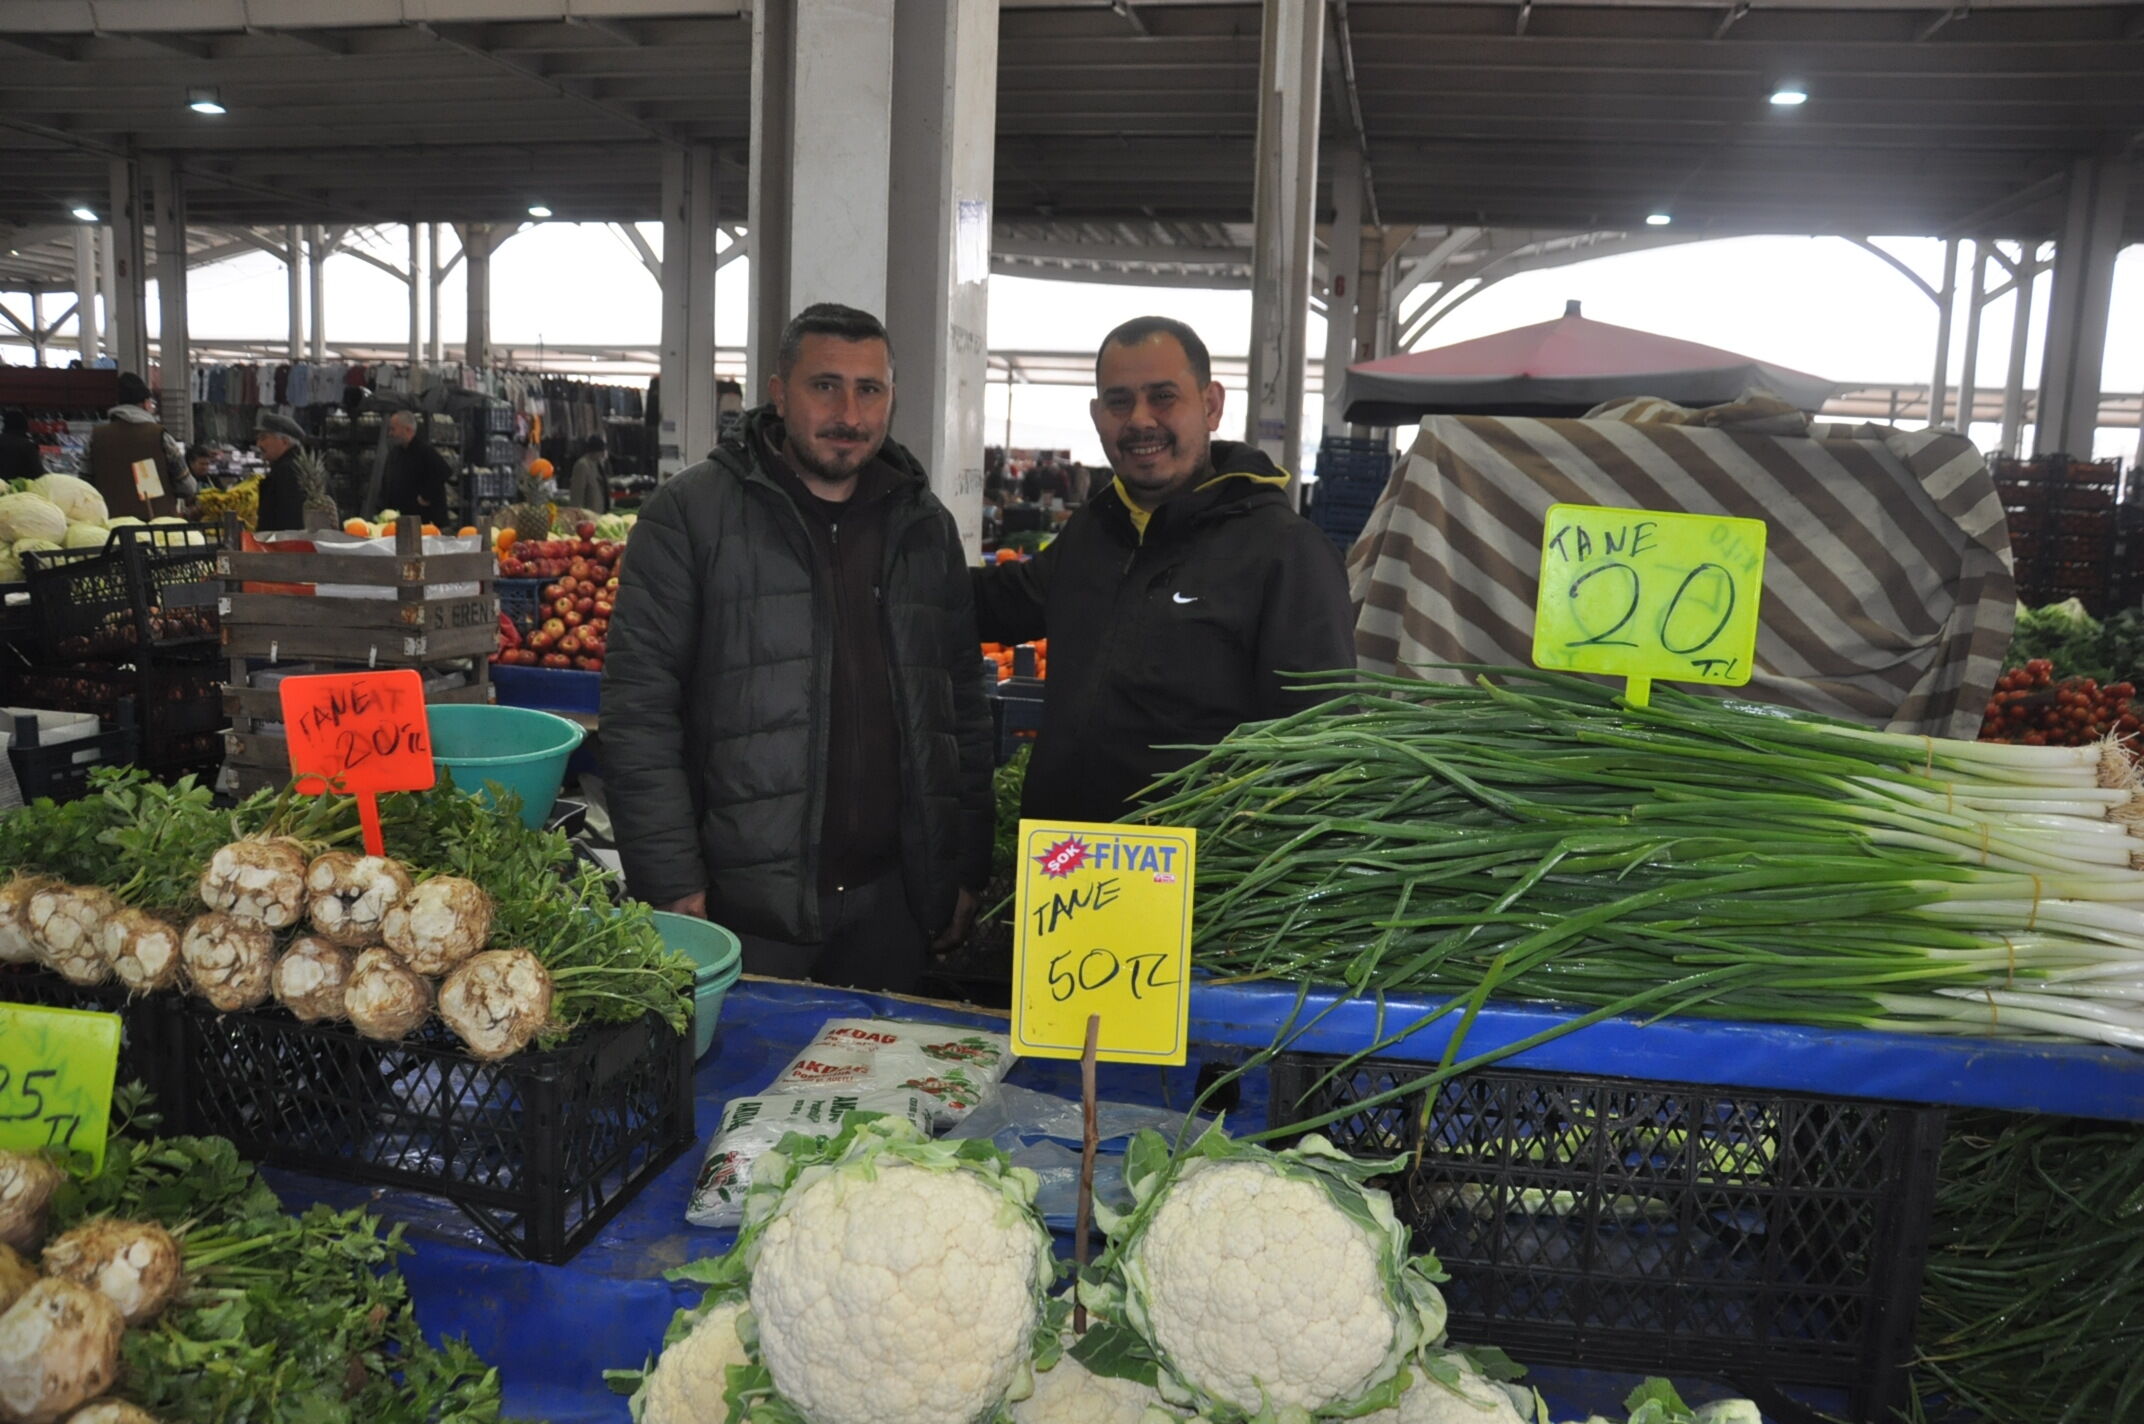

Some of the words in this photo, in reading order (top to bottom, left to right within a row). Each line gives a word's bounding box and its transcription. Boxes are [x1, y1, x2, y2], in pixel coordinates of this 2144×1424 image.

[1549, 521, 1658, 562] TANE
[1565, 562, 1736, 655] 20
[299, 680, 370, 738] TANE
[1047, 844, 1081, 872] ŞOK
[1094, 837, 1178, 873] FİYAT
[1033, 877, 1121, 937] TANE
